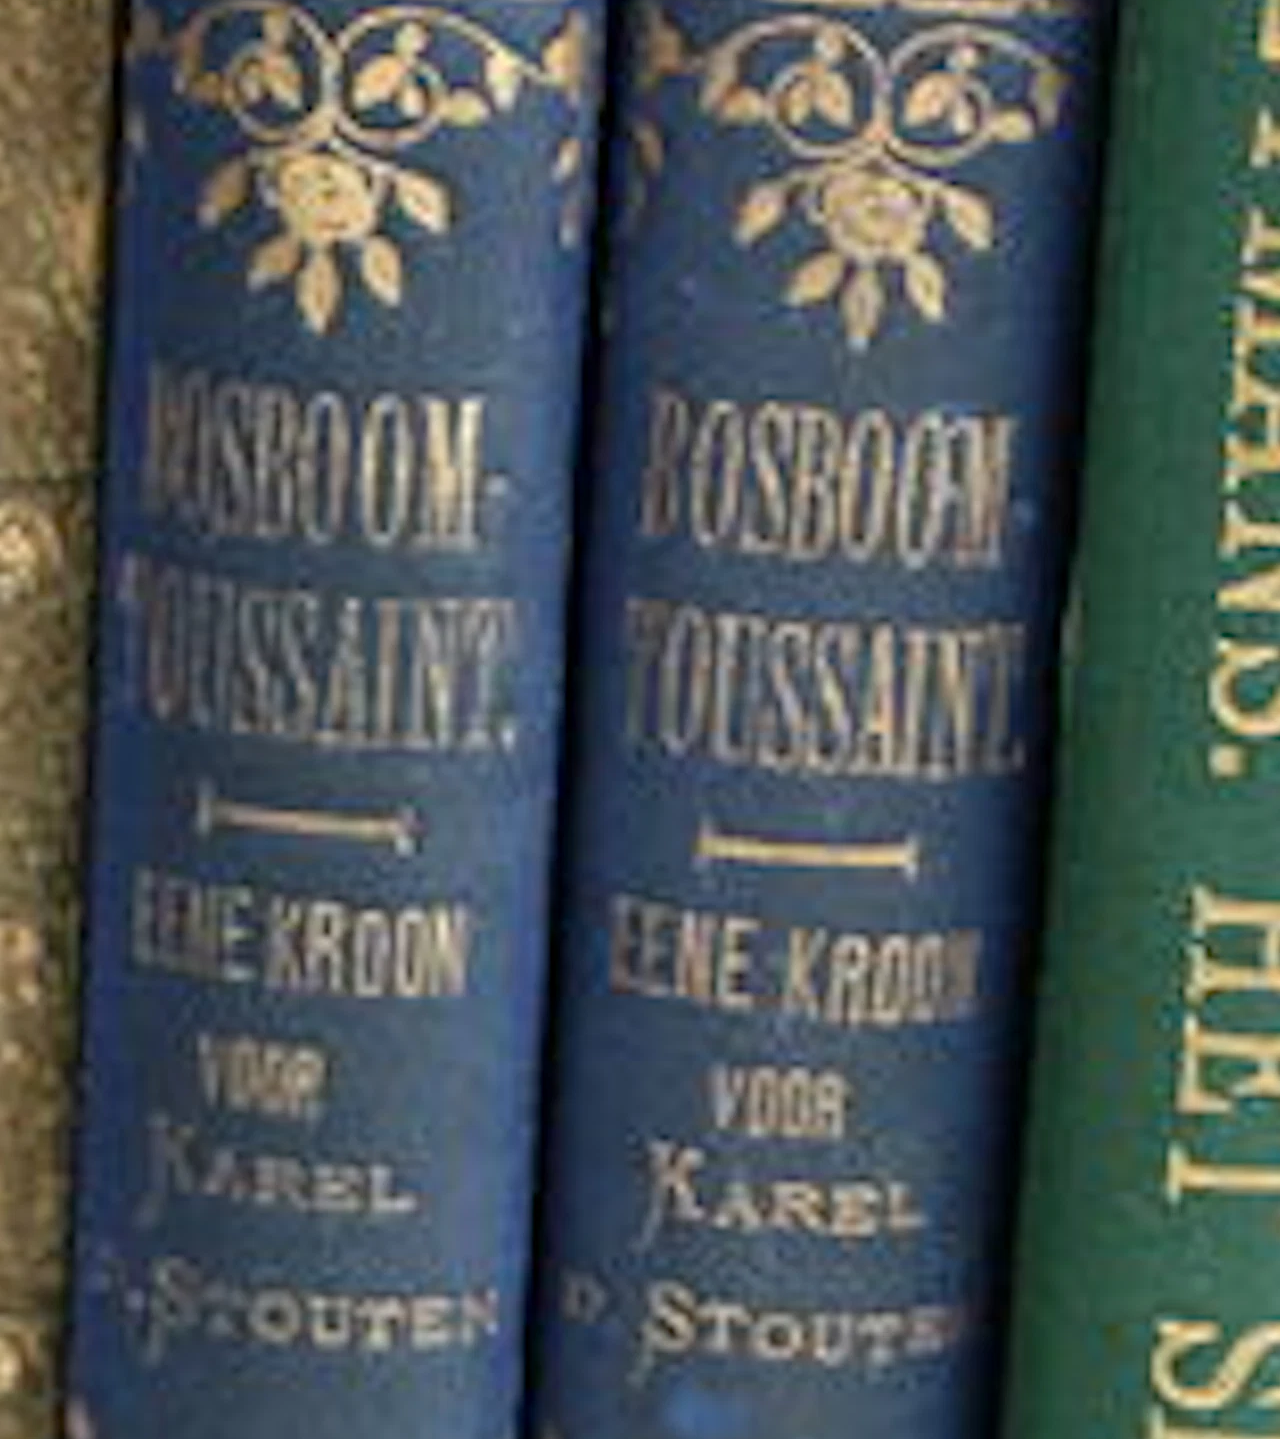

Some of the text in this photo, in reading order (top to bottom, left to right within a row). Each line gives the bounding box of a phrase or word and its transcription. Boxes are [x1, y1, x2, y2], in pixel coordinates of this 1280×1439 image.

[265, 891, 472, 998] KROON
[609, 891, 984, 1028] EENE KROON
[194, 1031, 330, 1121] VOOR
[703, 1063, 854, 1141] VOOR
[134, 1111, 424, 1229] KAREL
[628, 1137, 928, 1253] KAREL
